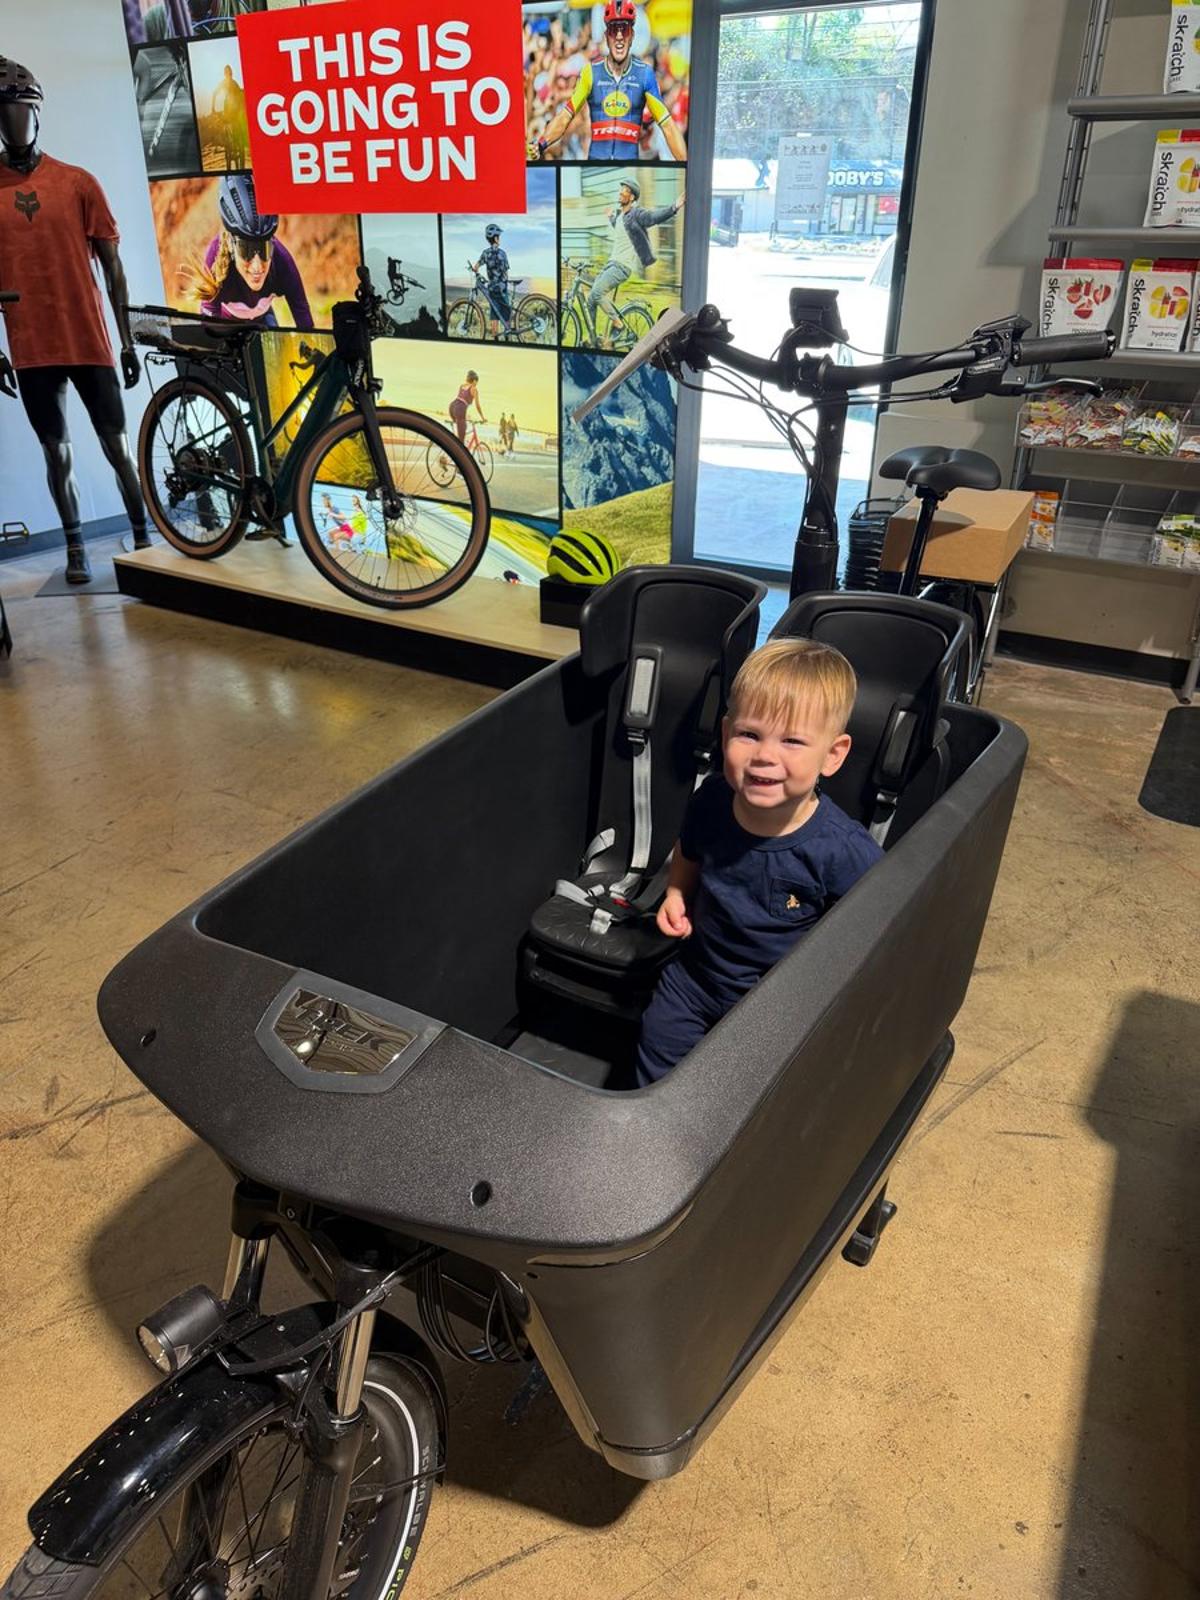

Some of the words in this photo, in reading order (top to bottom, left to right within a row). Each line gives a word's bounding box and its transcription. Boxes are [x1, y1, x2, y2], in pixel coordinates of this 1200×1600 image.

[278, 27, 404, 82] THIS
[416, 20, 472, 72] IS
[256, 83, 420, 137] GOING
[430, 76, 511, 126] TO
[289, 141, 355, 185] BE
[365, 135, 477, 183] FUN
